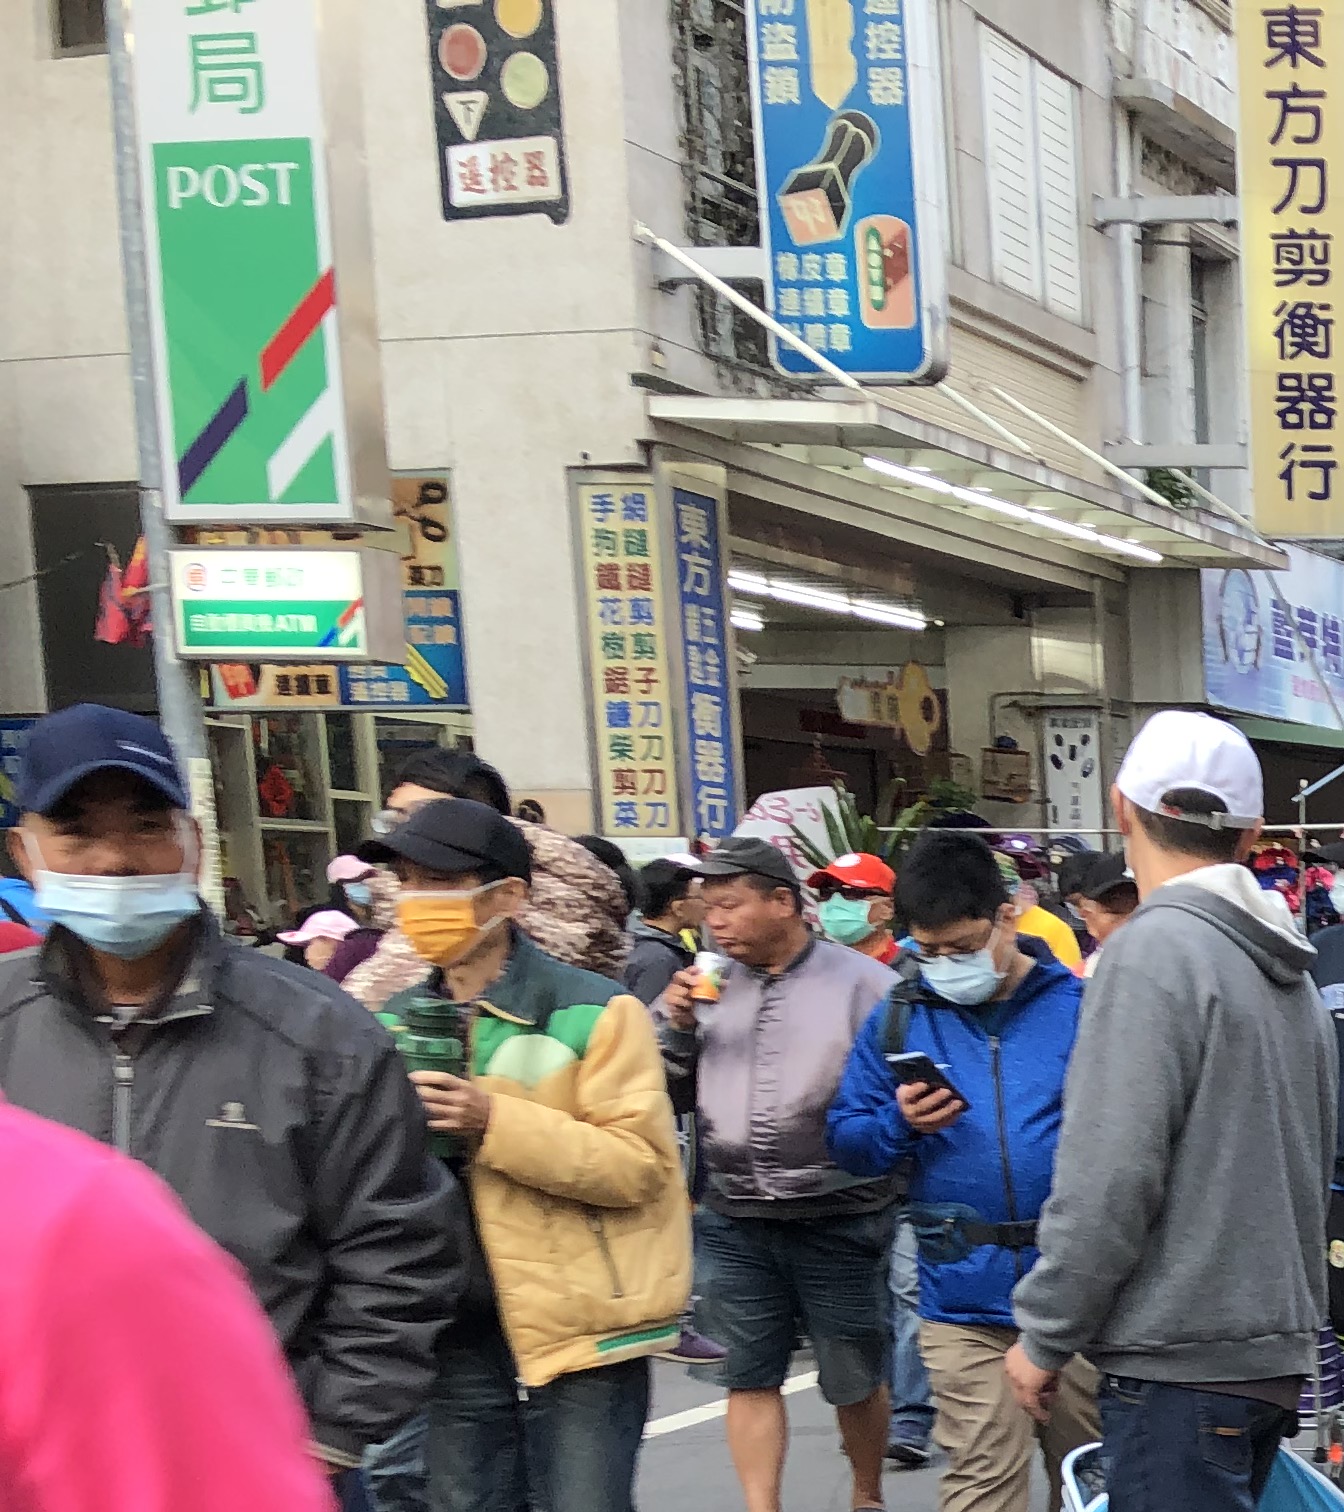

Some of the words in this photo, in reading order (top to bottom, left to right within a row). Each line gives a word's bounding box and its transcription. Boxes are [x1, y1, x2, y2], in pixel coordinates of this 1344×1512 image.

[167, 162, 300, 209] POST
[1262, 5, 1338, 500] 東方刀剪衡器行
